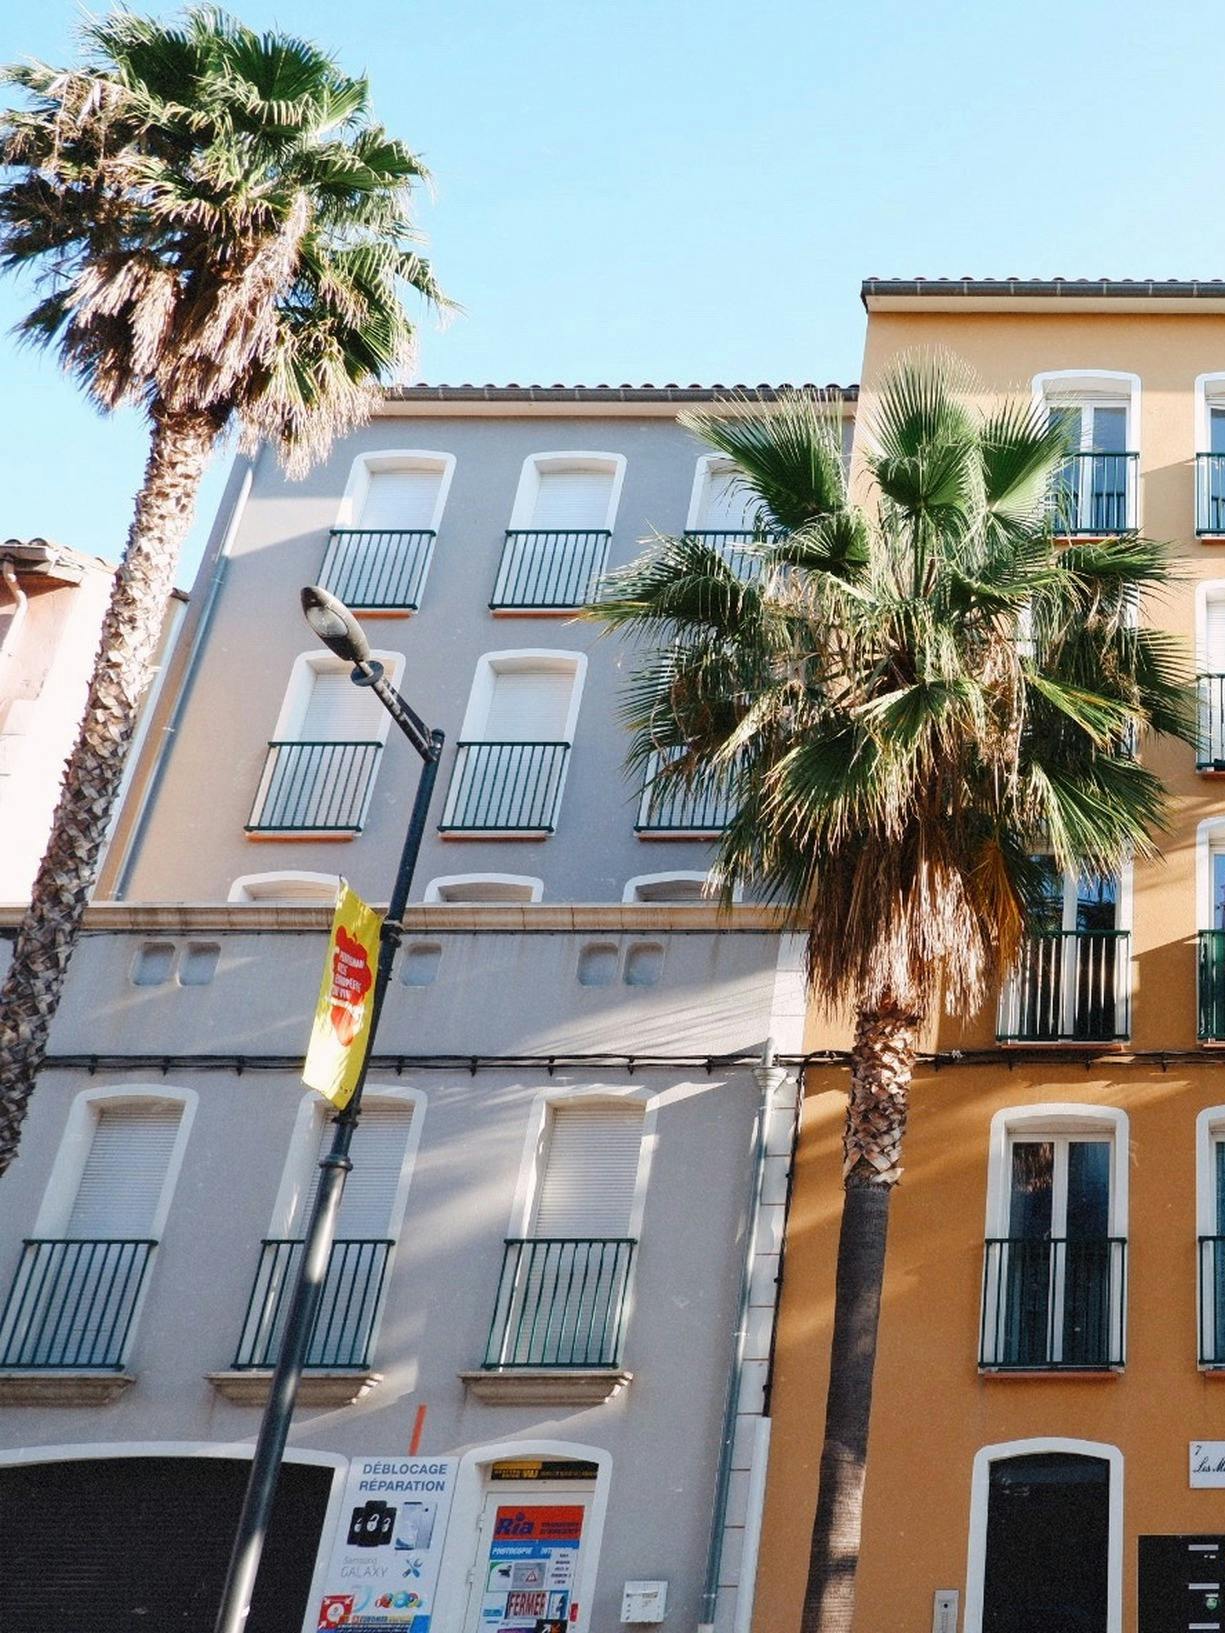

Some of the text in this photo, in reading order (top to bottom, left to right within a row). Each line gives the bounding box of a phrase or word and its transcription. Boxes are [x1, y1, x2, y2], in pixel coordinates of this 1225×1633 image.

[1194, 1444, 1202, 1456] 7
[363, 1461, 448, 1475] DÉBLOCAGE
[1193, 1456, 1211, 1473] Les
[359, 1478, 446, 1492] RÉPARATION
